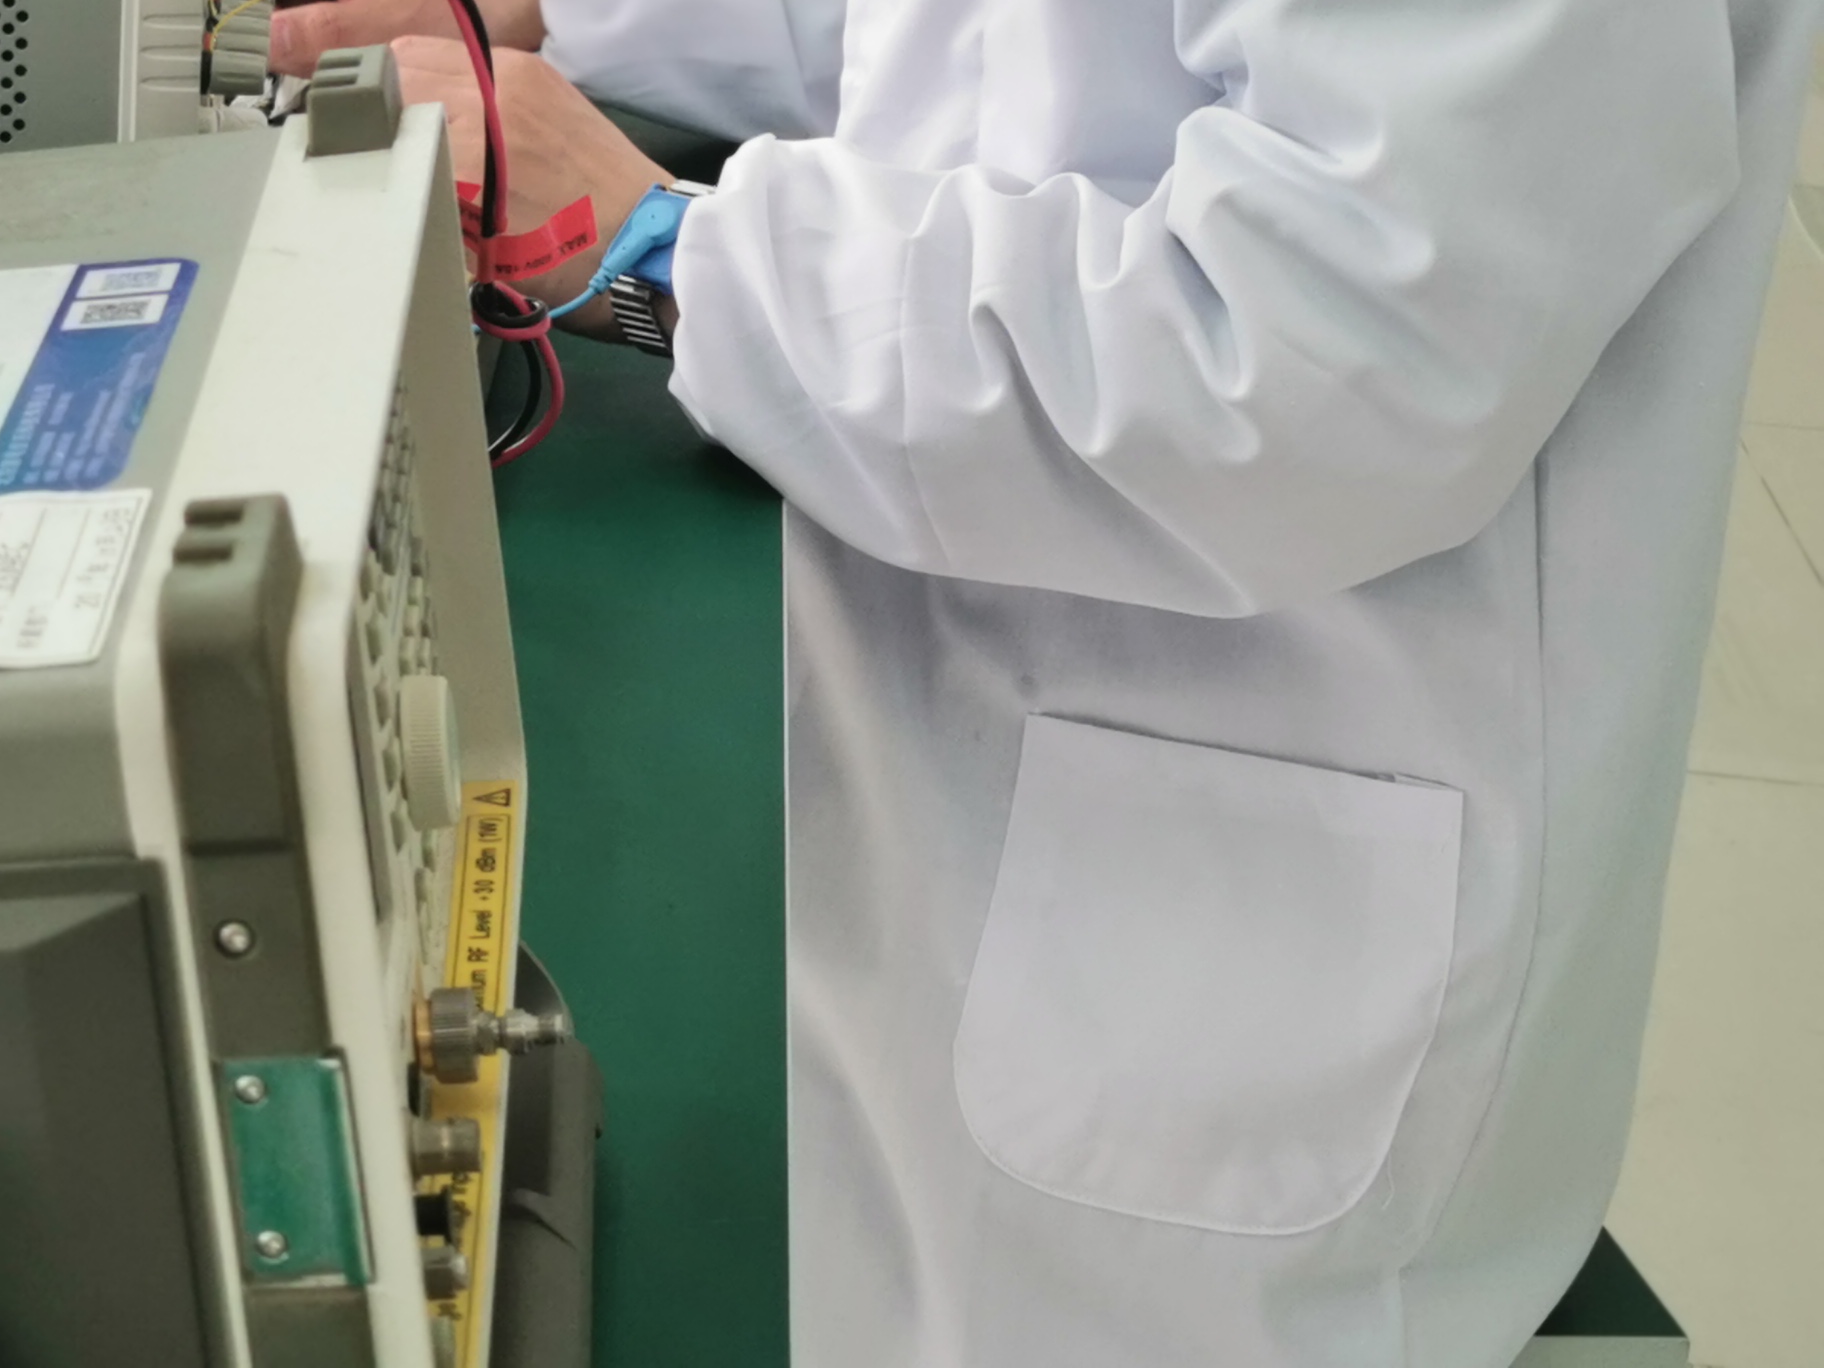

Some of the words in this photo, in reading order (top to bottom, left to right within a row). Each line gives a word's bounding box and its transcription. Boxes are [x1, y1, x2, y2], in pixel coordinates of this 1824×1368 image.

[478, 817, 504, 843] (1W)
[475, 847, 497, 873] dBm
[468, 910, 492, 940] Level
[467, 946, 489, 963] RF
